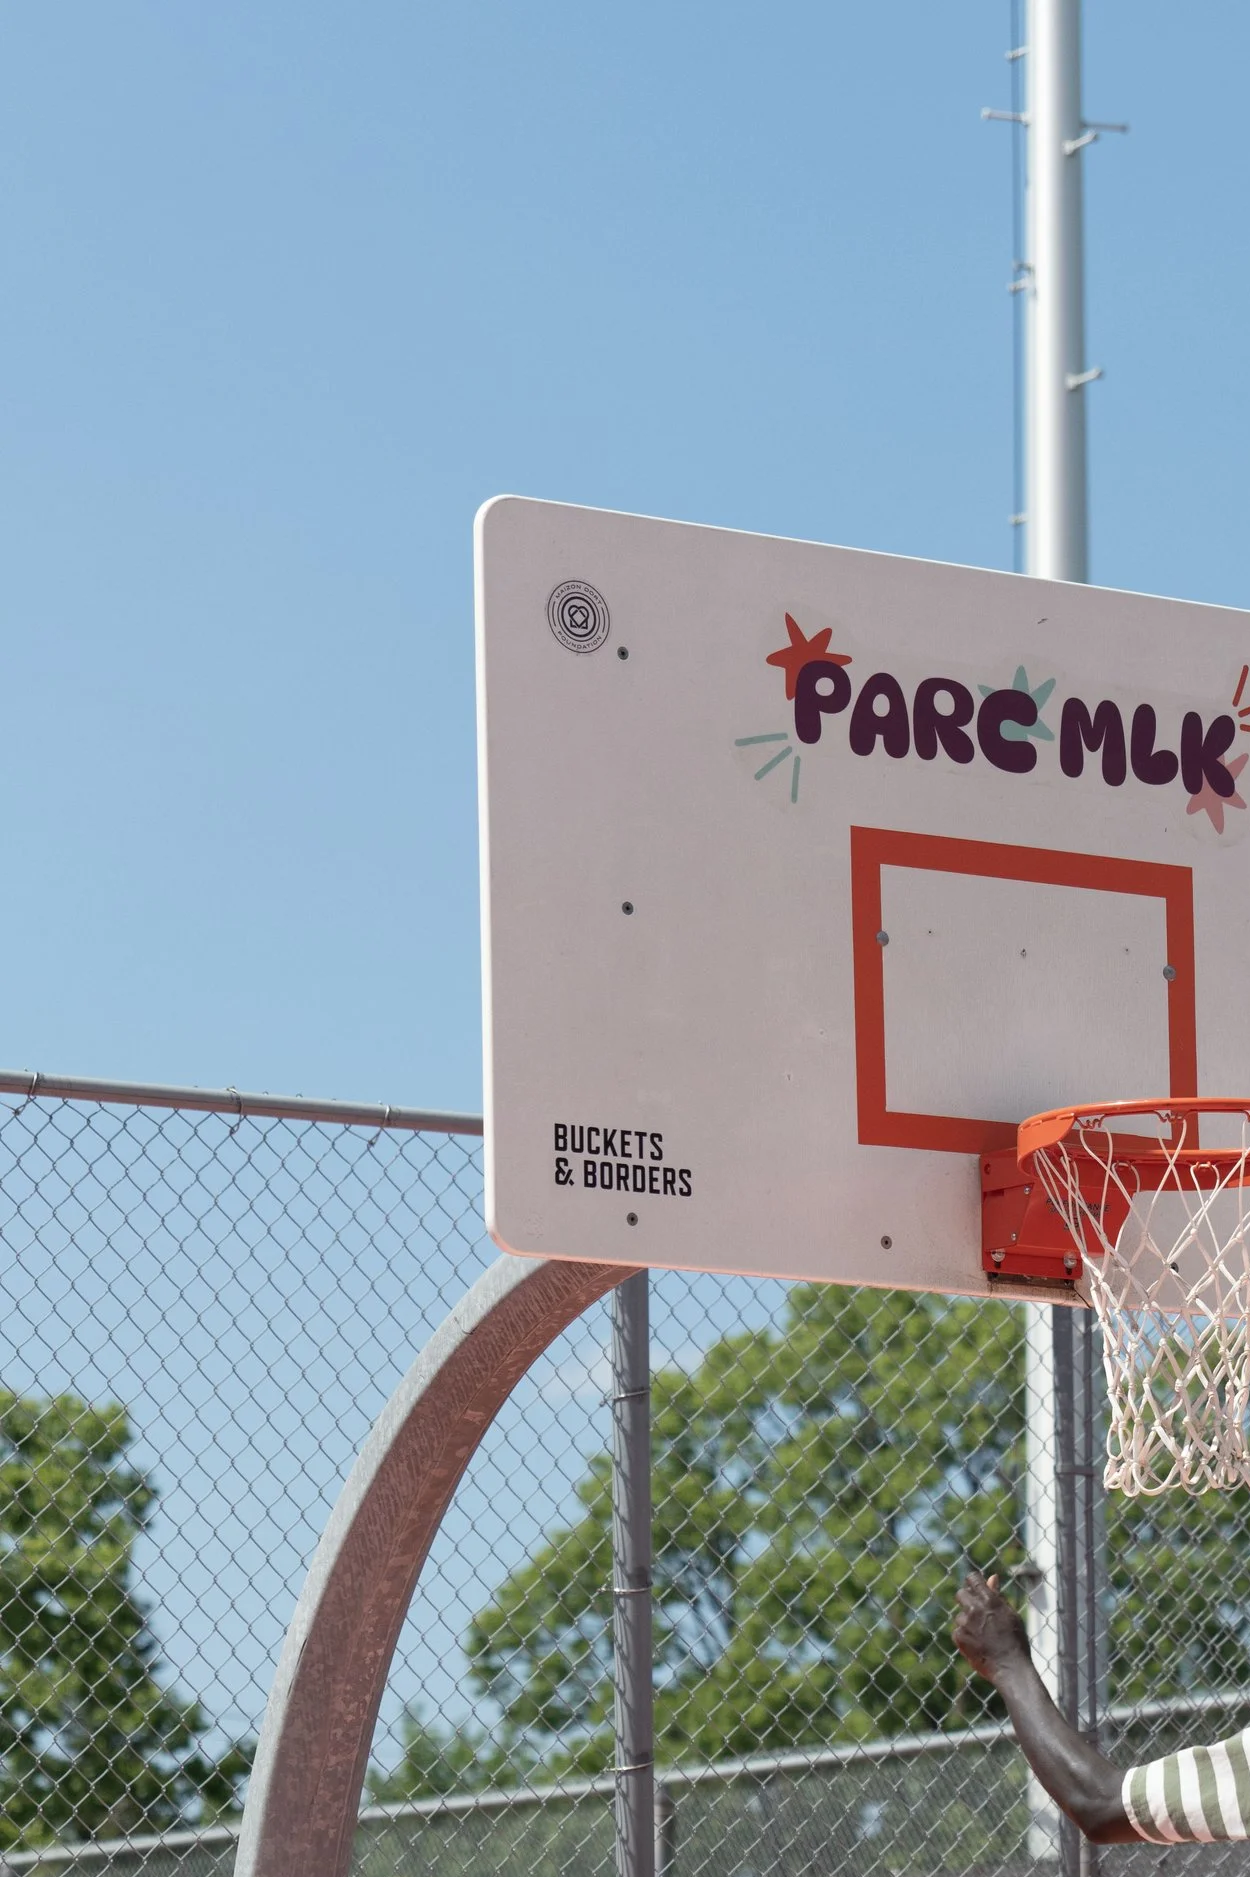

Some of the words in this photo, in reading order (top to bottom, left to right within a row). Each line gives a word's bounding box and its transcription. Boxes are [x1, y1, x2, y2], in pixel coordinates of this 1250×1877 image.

[794, 660, 1038, 774] PARC
[1059, 698, 1236, 798] MLK
[554, 1122, 664, 1162] BUCKETS
[554, 1156, 575, 1187] &
[583, 1159, 693, 1198] BORDERS
